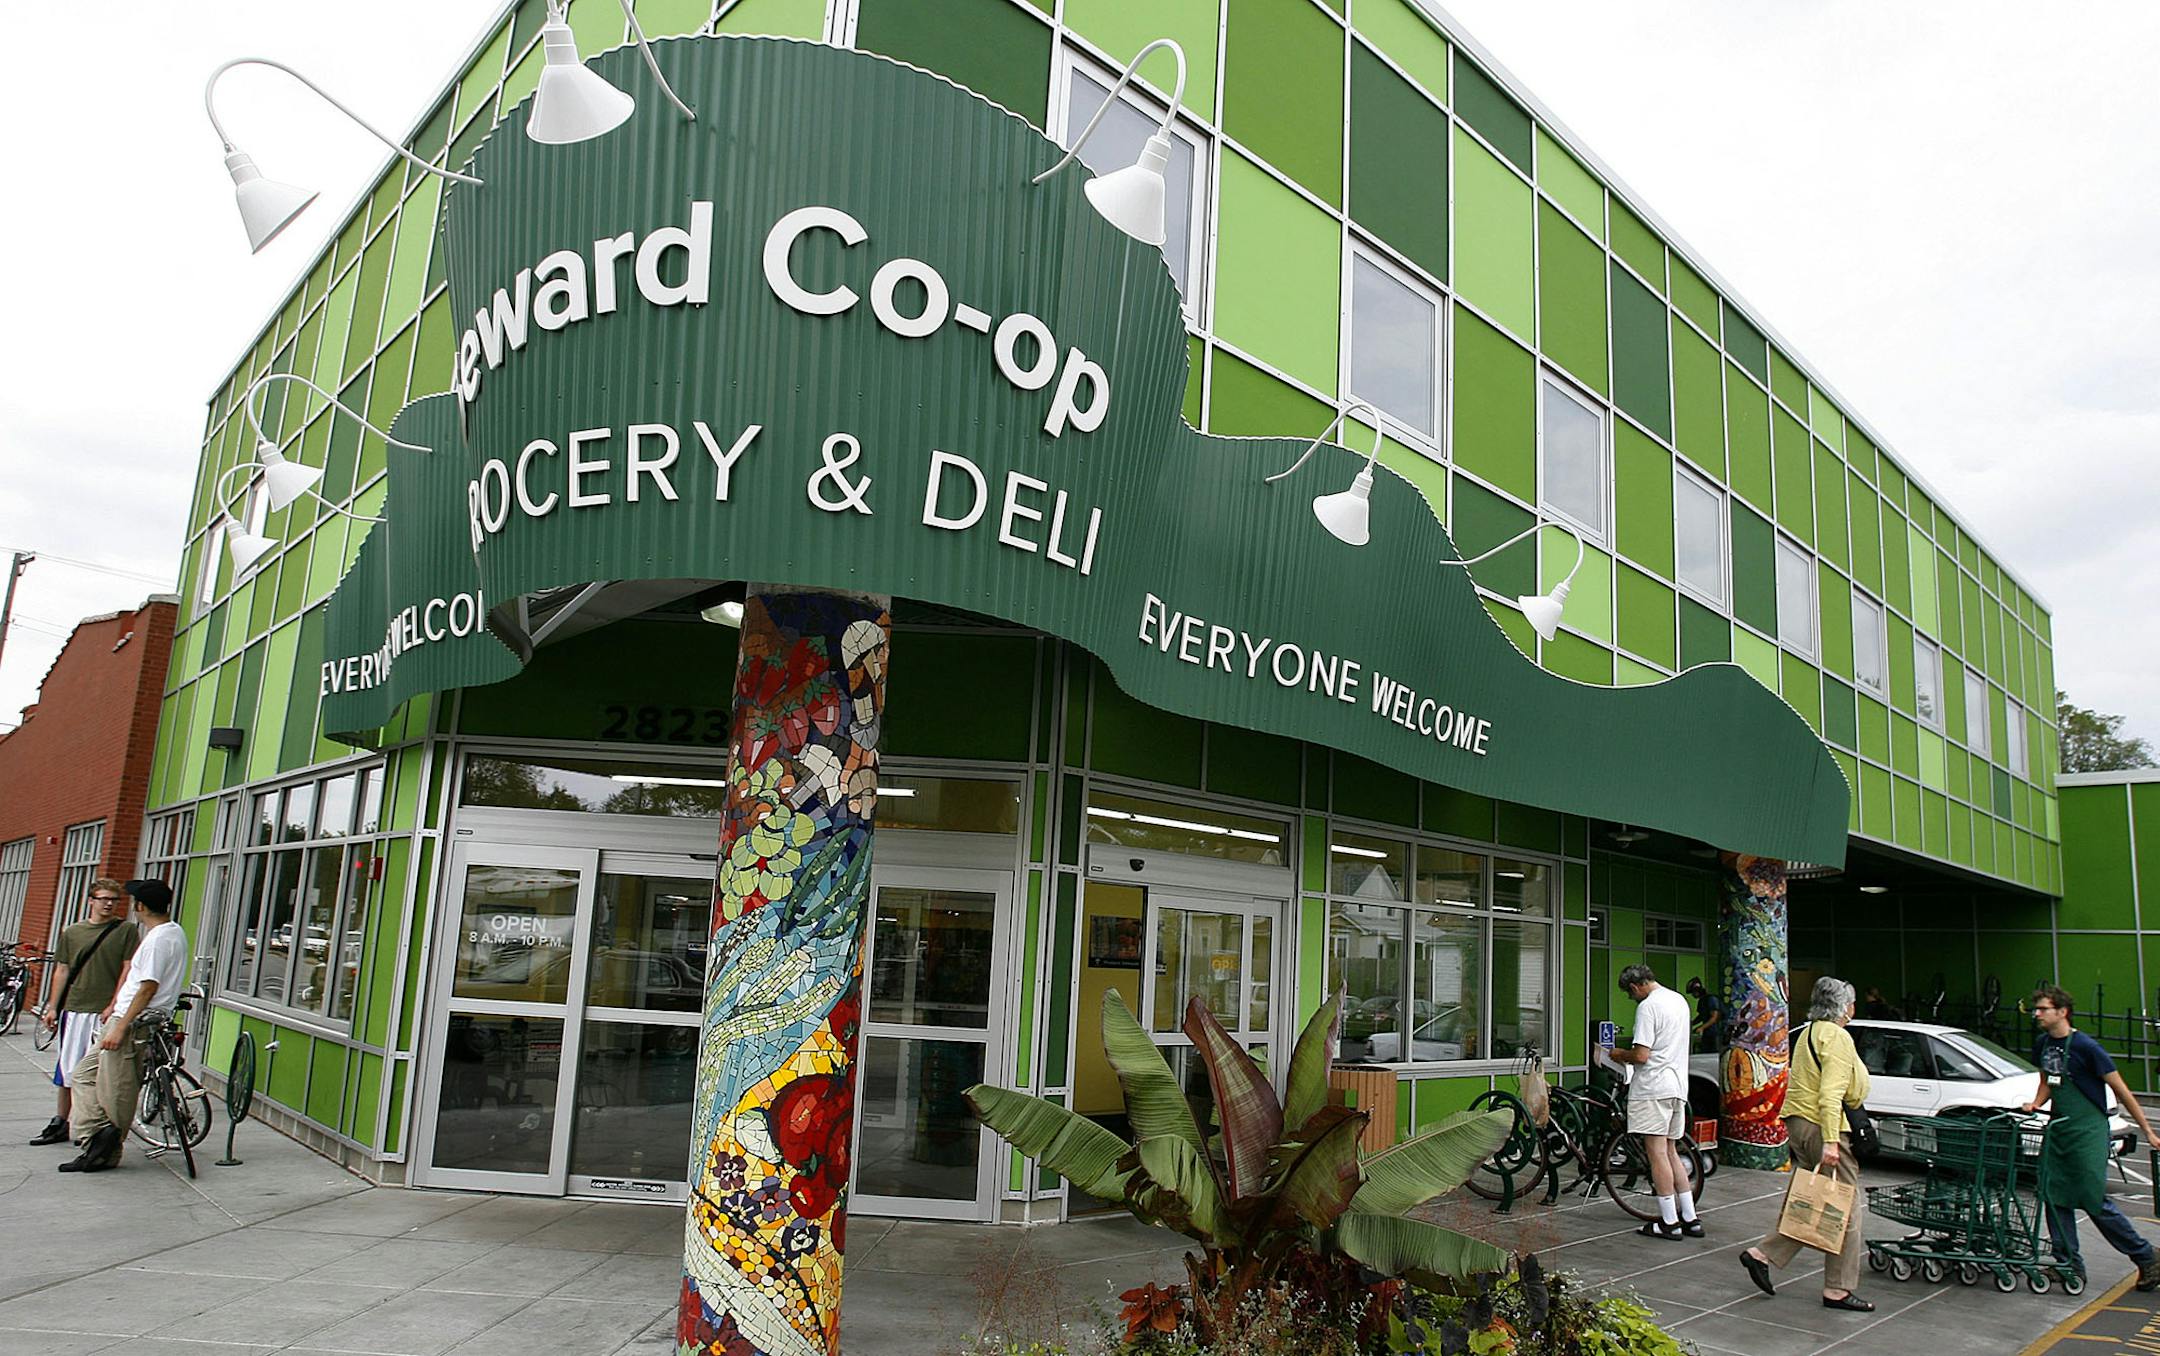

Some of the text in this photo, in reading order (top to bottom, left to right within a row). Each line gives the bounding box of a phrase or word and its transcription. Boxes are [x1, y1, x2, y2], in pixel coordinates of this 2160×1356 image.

[451, 201, 1110, 438] eward Co-op
[468, 421, 1102, 575] ROCERY & DELI
[322, 589, 484, 696] EVERY WELCO
[1138, 592, 1492, 756] EVERYONE WELCOME
[601, 705, 729, 742] 2823
[468, 931, 478, 943] 8
[480, 932, 510, 945] A.M.
[520, 935, 535, 946] 10
[538, 936, 565, 948] P.M.
[491, 914, 546, 933] OPEN
